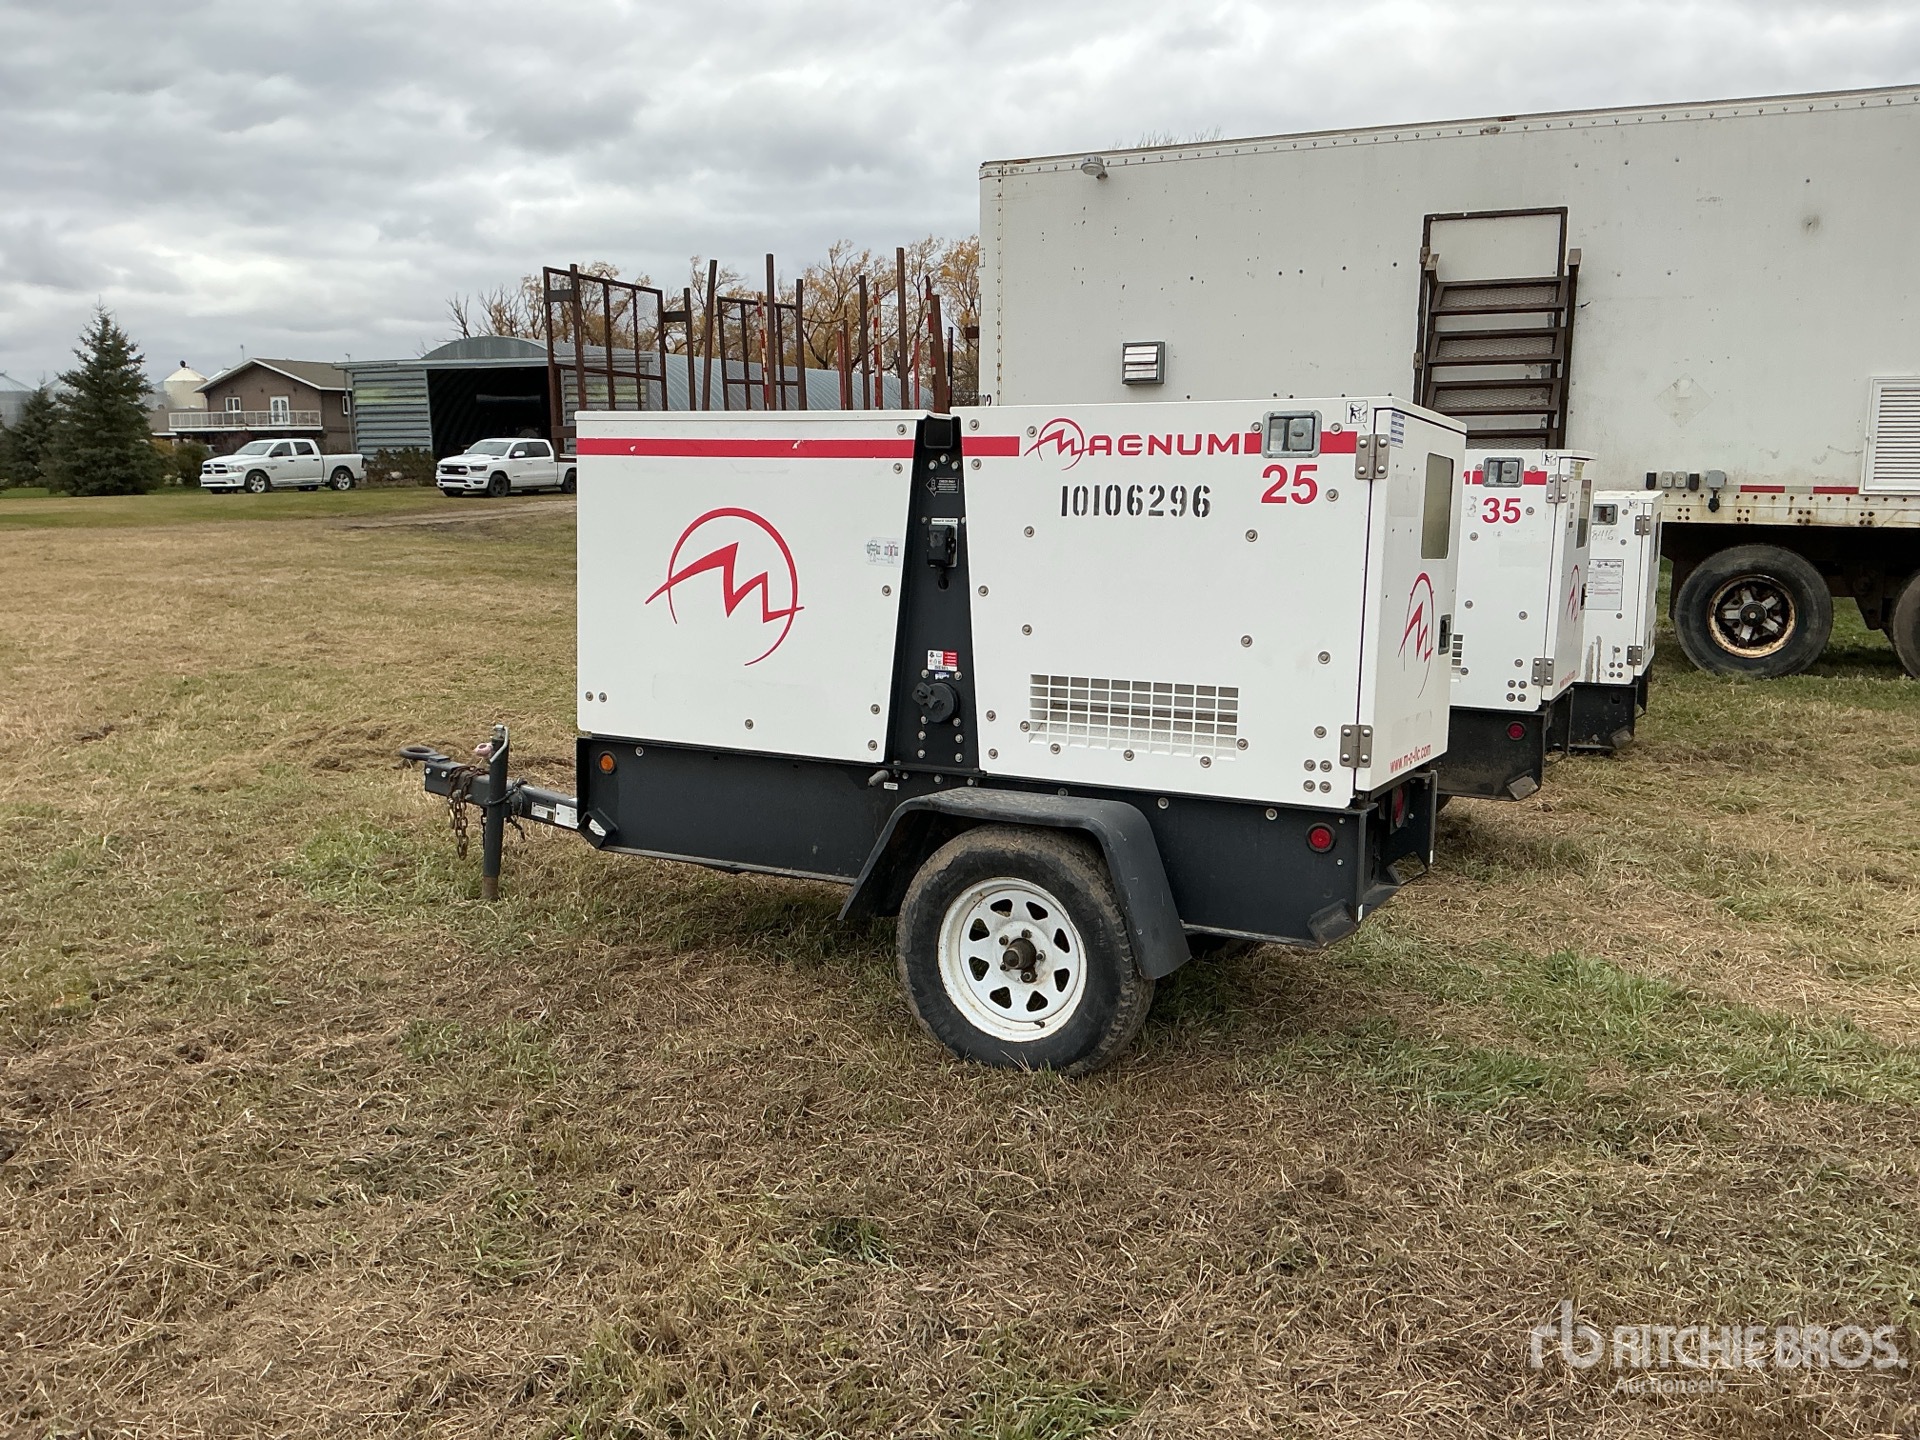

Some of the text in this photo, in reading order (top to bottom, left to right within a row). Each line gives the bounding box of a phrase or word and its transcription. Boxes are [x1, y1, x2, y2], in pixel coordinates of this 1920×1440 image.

[1061, 484, 1211, 518] 10106296
[1261, 464, 1318, 504] 25
[1482, 498, 1521, 524] 35
